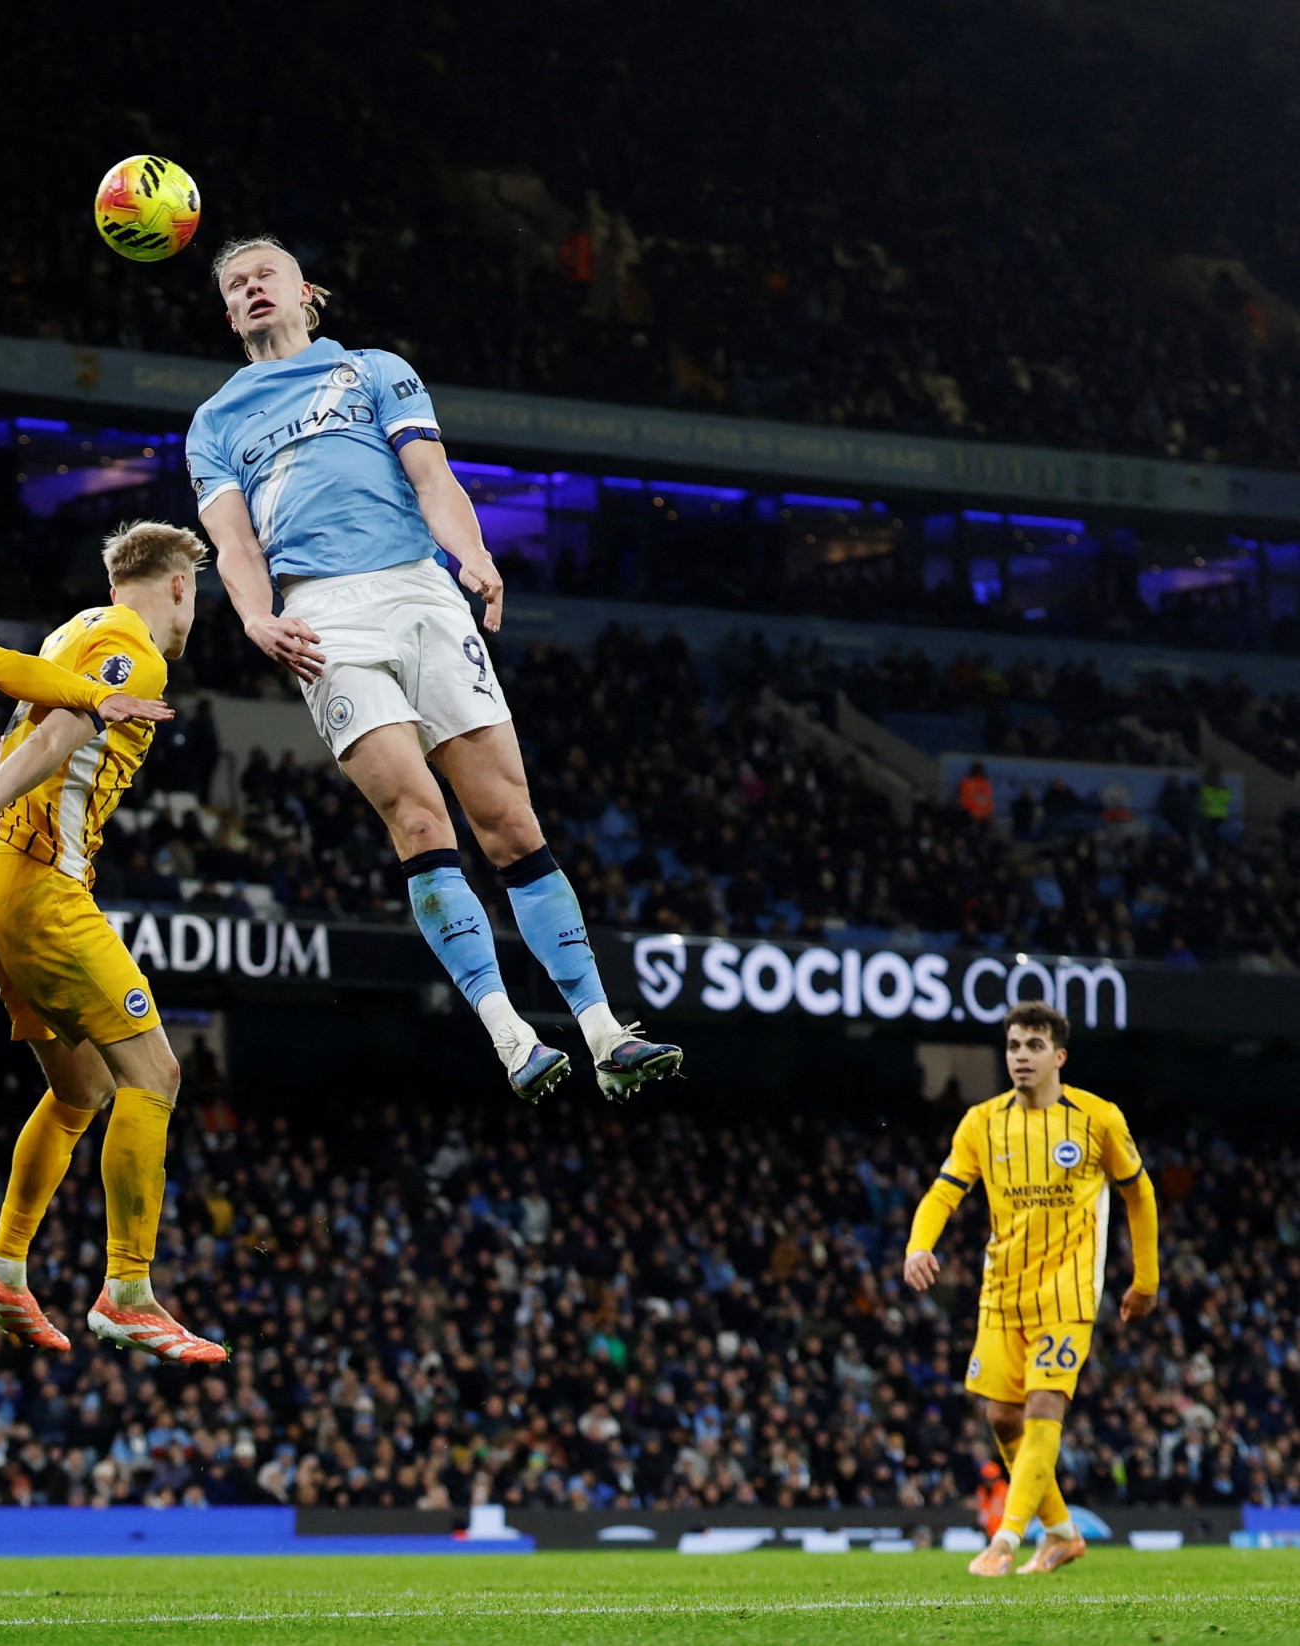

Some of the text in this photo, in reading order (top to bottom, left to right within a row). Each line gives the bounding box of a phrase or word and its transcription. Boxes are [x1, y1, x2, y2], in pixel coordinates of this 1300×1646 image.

[242, 404, 375, 465] ETIHAD
[463, 636, 486, 681] 9
[440, 916, 474, 934] CITY
[107, 911, 332, 980] TADIUM
[1003, 1183, 1074, 1197] AMERICAN
[1012, 1198, 1075, 1210] EXPRESS
[1036, 1335, 1077, 1369] 26
